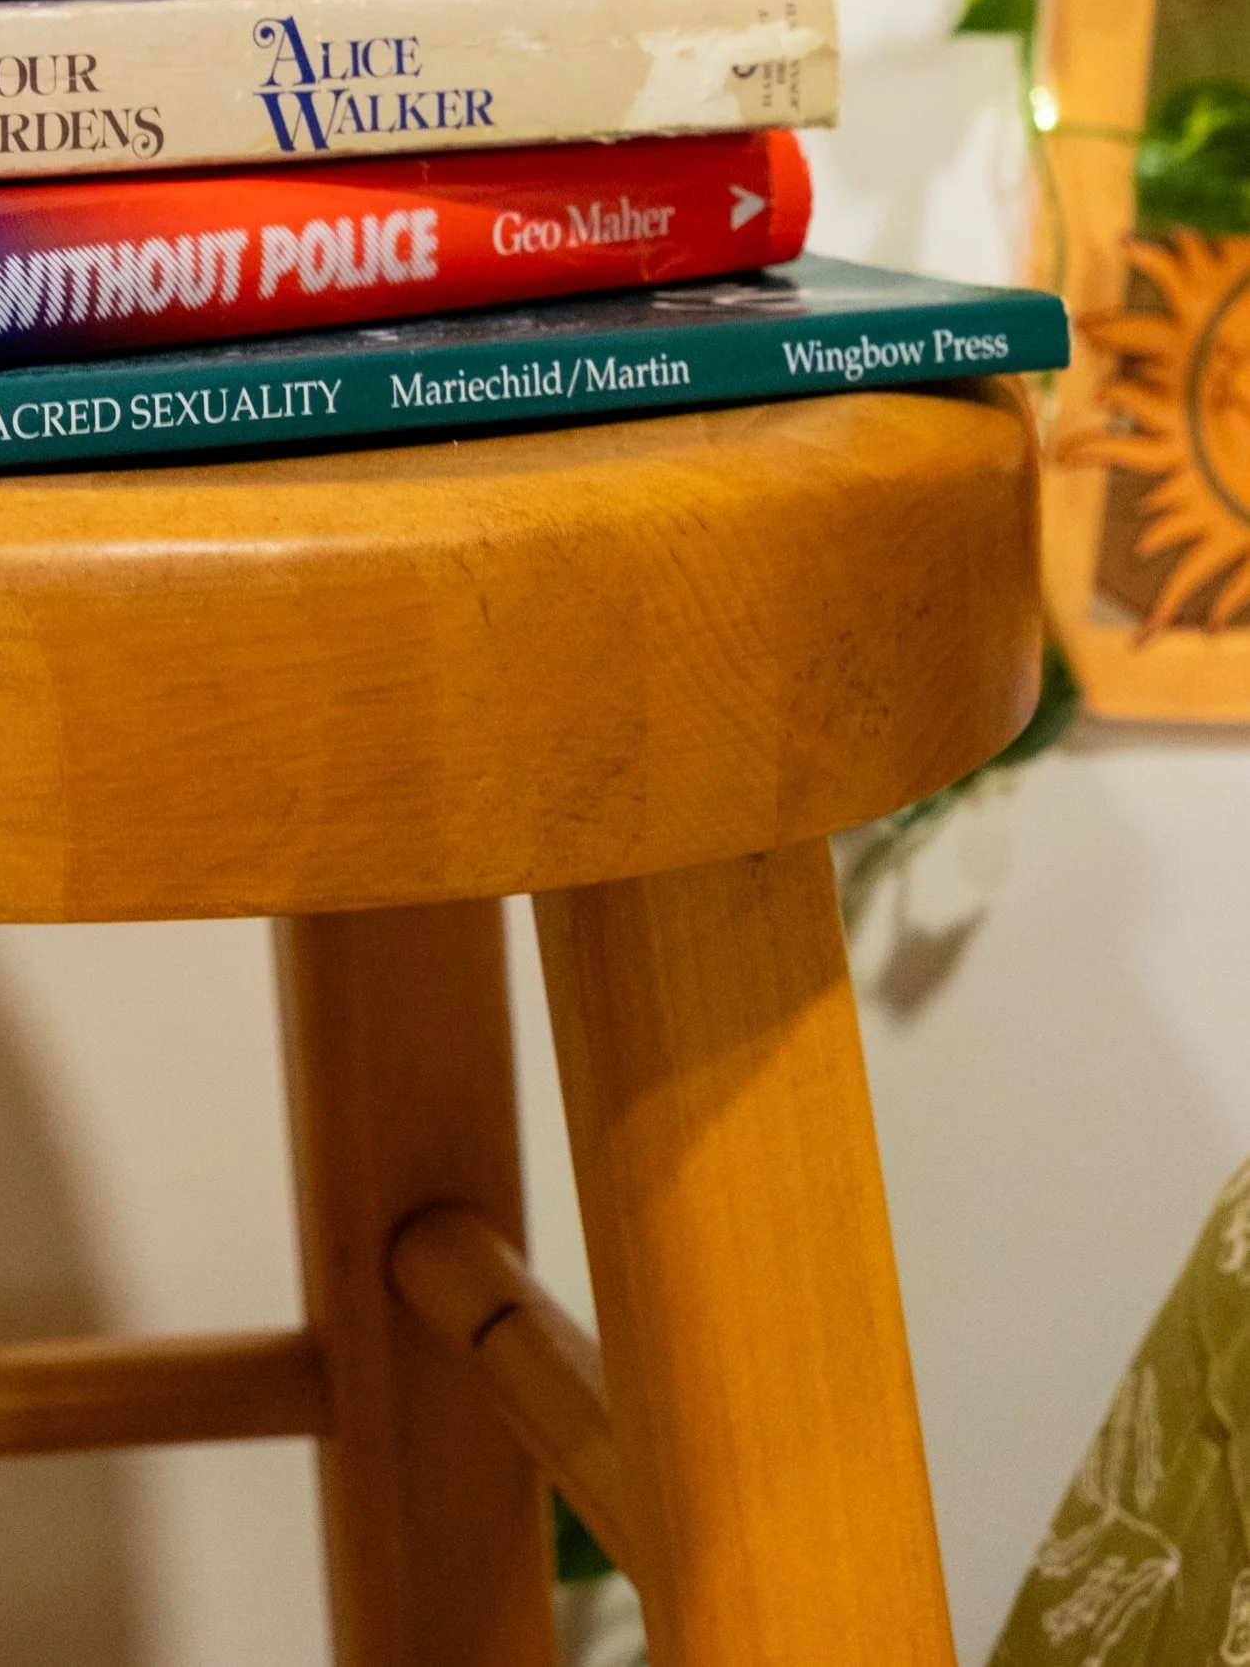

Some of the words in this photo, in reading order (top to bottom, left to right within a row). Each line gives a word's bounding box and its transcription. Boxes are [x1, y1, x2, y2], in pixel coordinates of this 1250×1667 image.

[258, 208, 440, 298] POLICE
[492, 210, 561, 256] Geo
[567, 196, 675, 248] Maher
[390, 354, 690, 409] Mariechild/Martin
[782, 333, 925, 381] Wingbow
[933, 328, 1010, 364] Press
[130, 374, 345, 429] SEXUALITY
